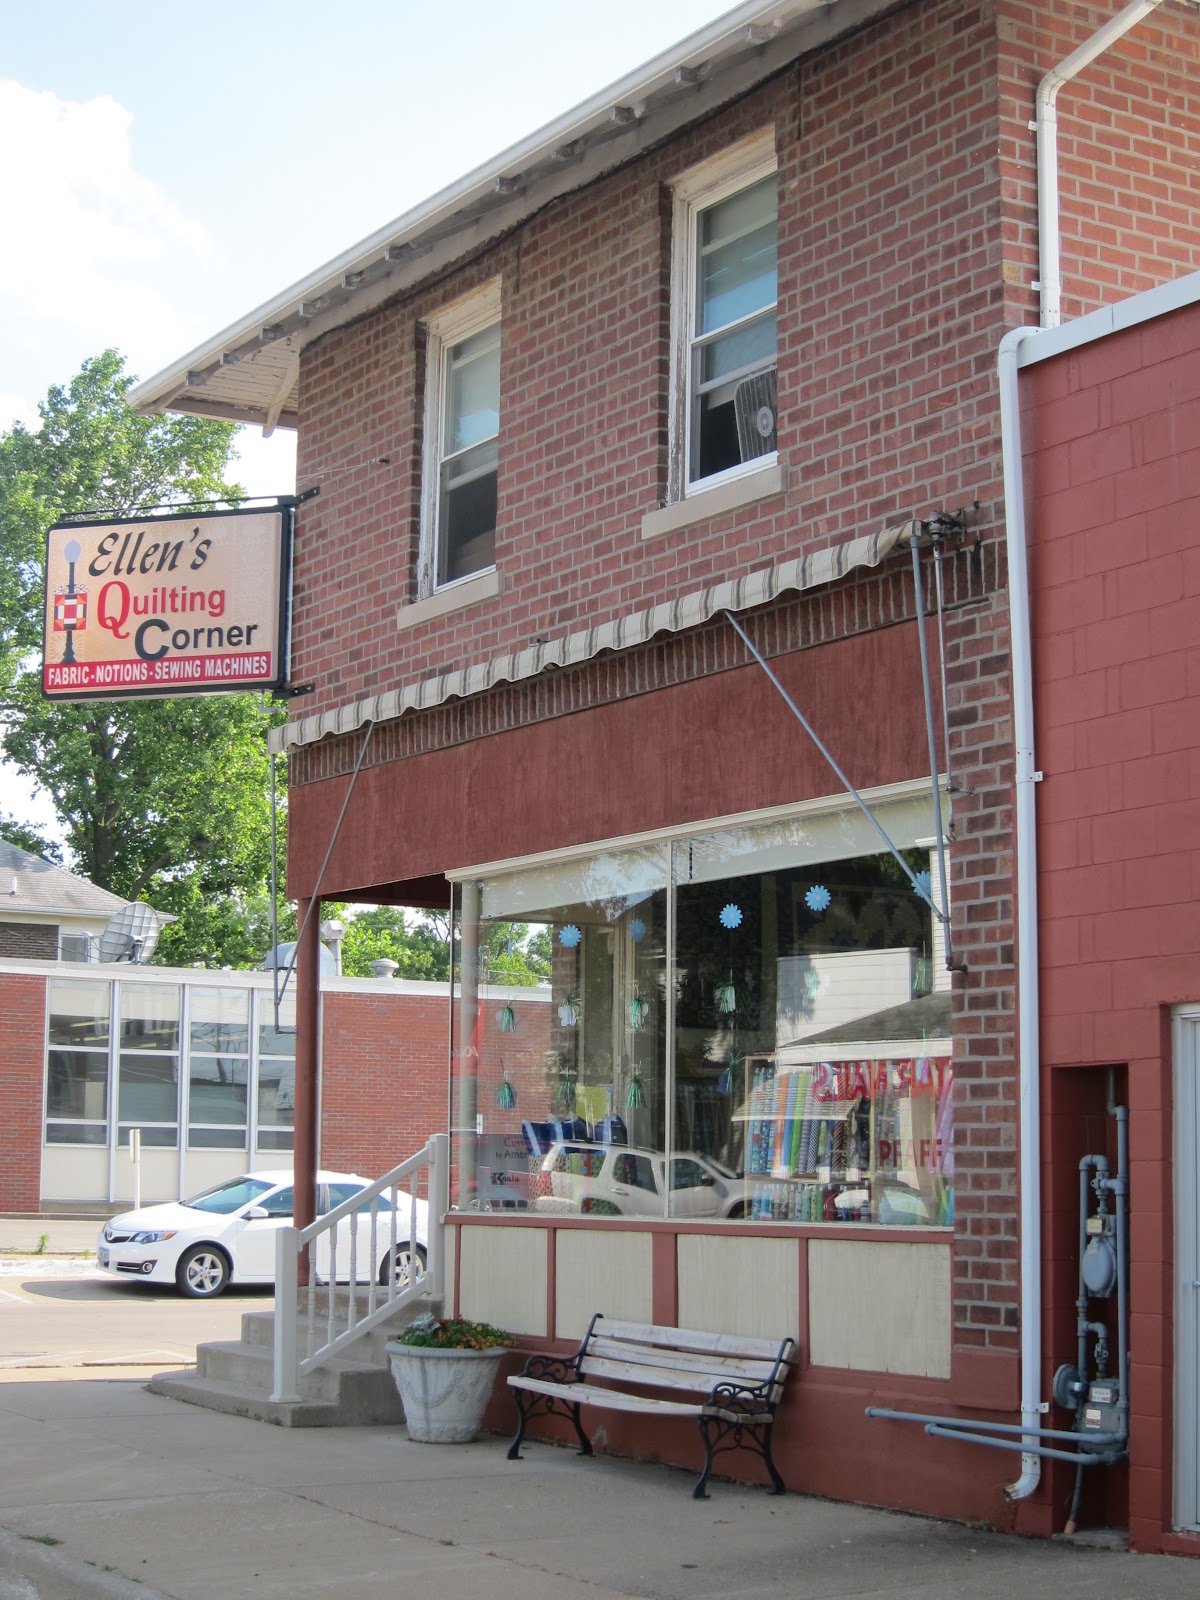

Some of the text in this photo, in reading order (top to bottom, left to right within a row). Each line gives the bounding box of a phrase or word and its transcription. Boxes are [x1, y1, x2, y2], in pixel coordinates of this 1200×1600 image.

[88, 526, 213, 577] Ellen's
[97, 580, 226, 639] Quilting
[134, 618, 258, 661] Corner
[204, 656, 267, 677] MACHINES
[879, 1138, 942, 1168] PFAFF
